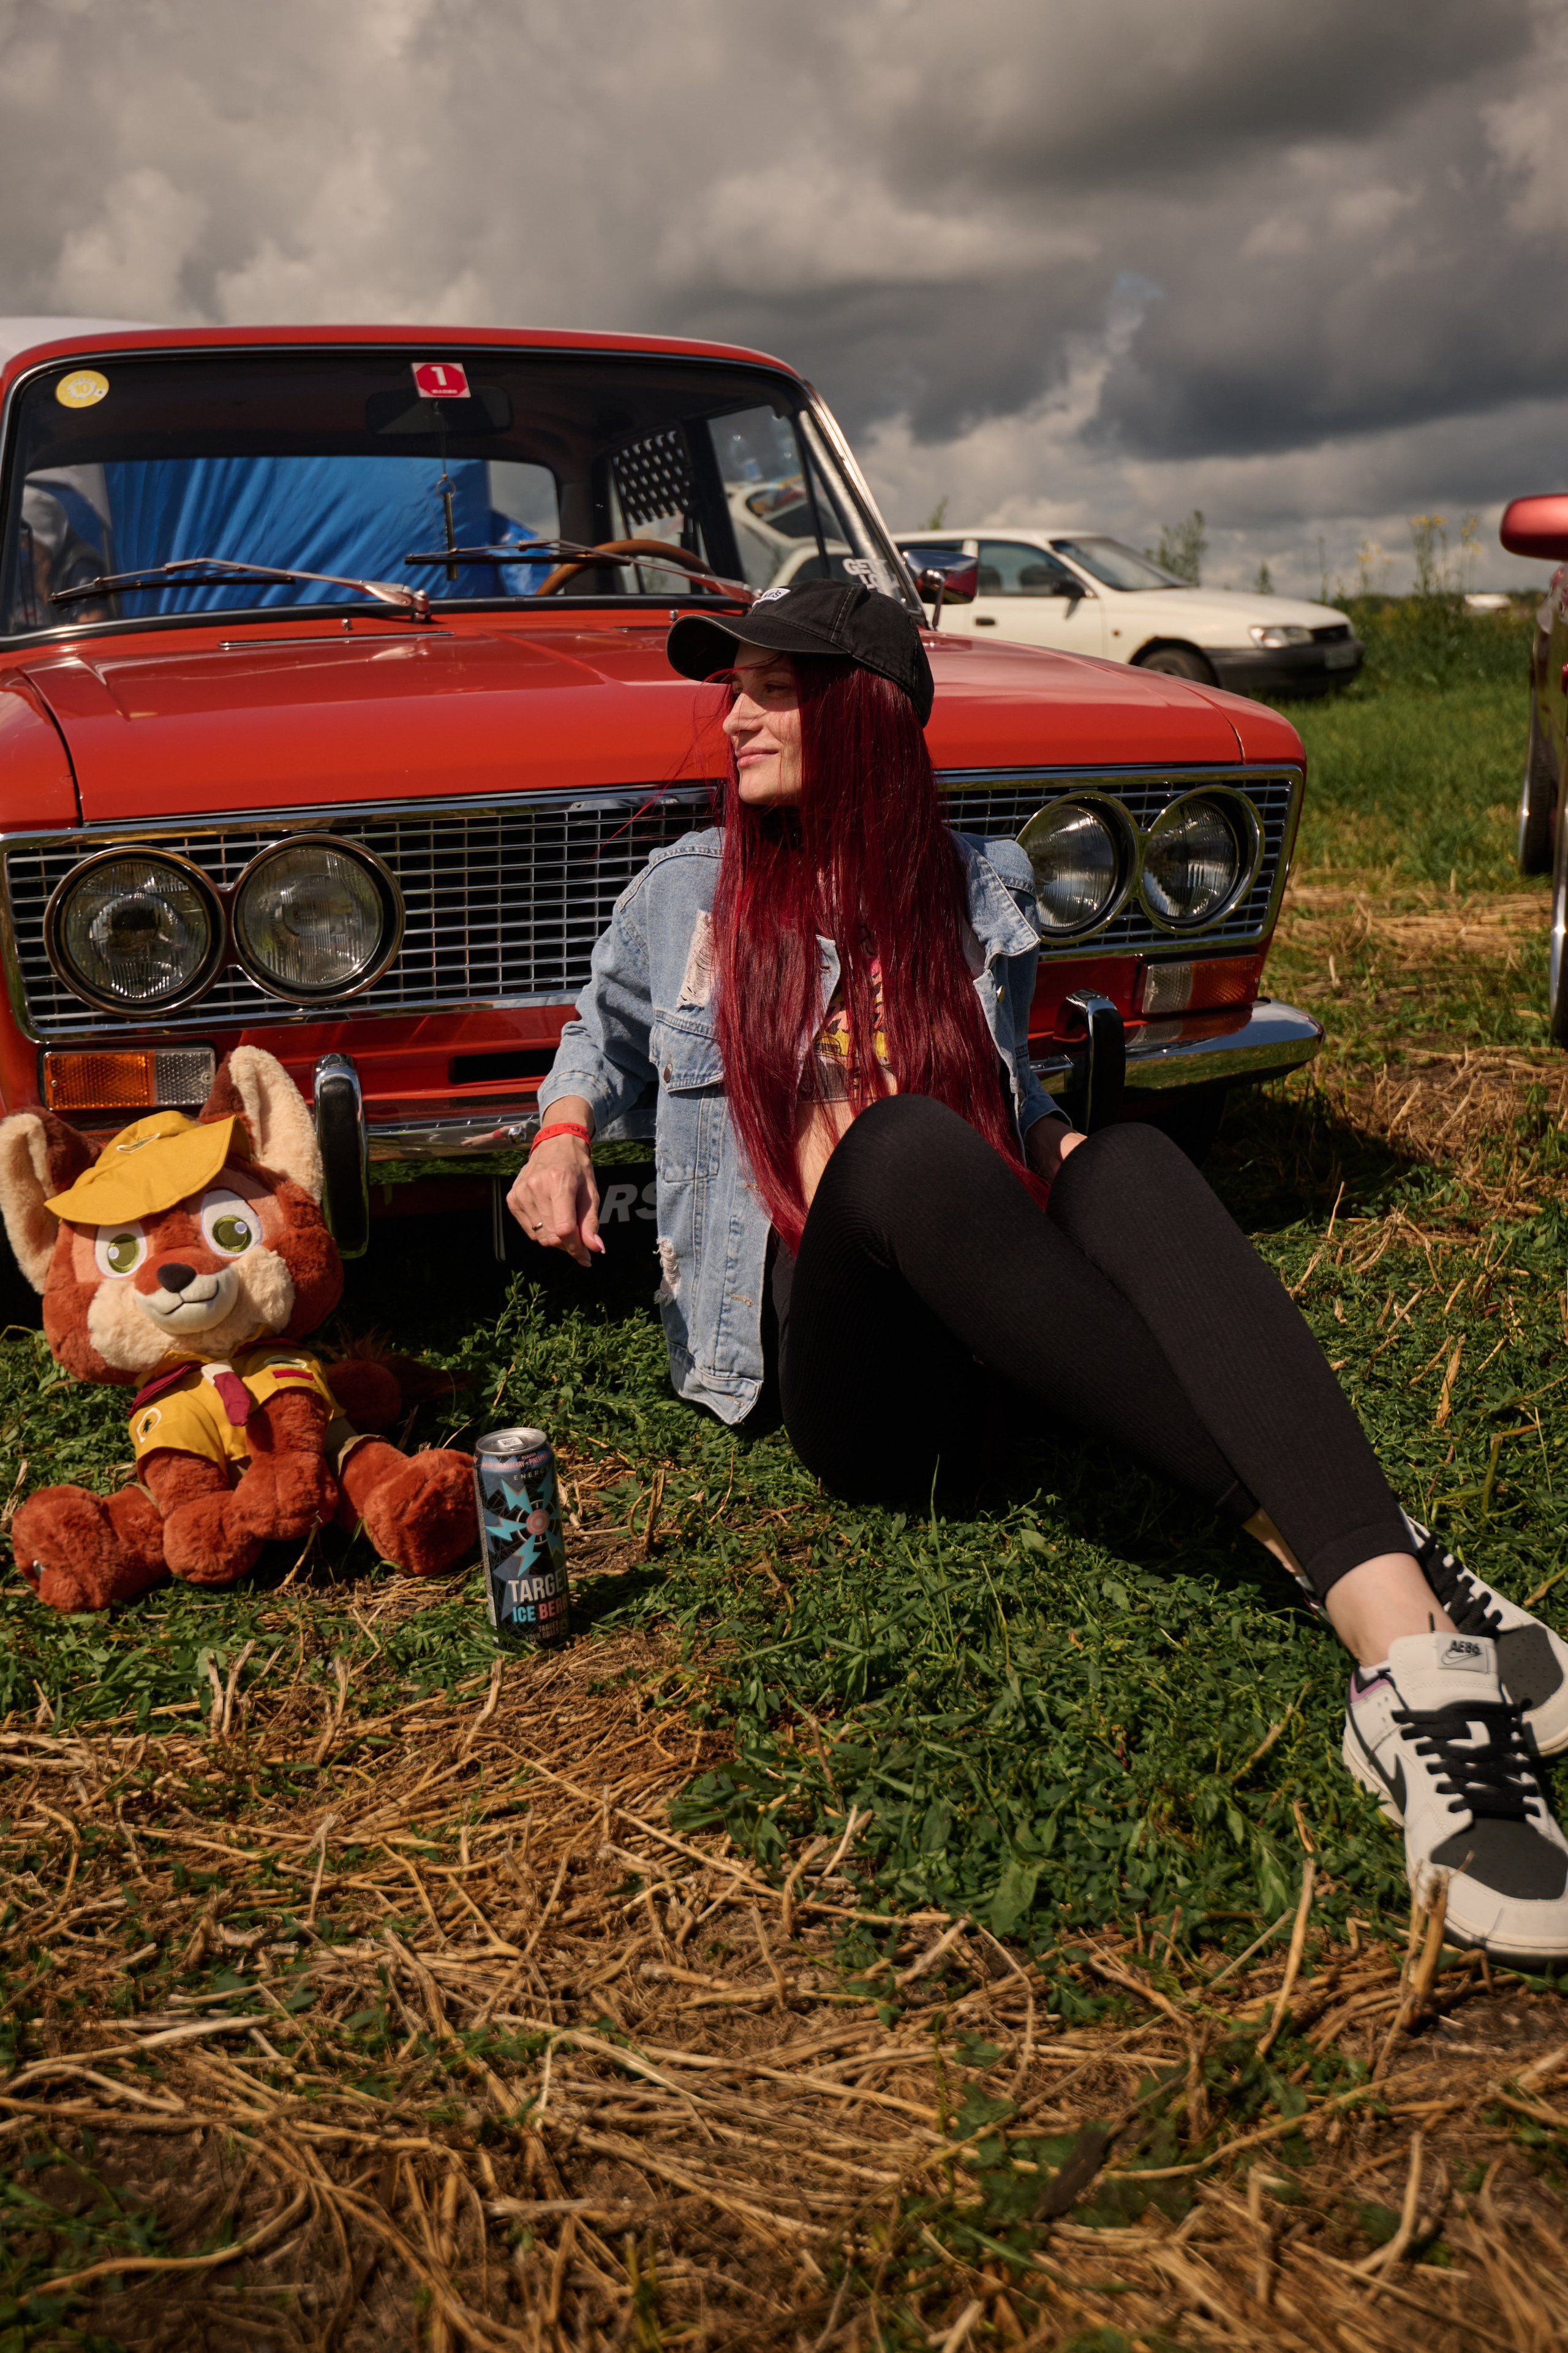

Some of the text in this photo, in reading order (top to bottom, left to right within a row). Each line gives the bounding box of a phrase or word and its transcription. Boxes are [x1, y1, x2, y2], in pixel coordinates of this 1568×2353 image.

[430, 366, 447, 386] 1
[73, 382, 90, 395] 10
[514, 1467, 546, 1481] ENERG
[513, 1593, 568, 1622] ICE BERR
[538, 1620, 559, 1633] TARGET
[525, 1632, 541, 1641] YOUR
[1448, 1639, 1481, 1655] AE86
